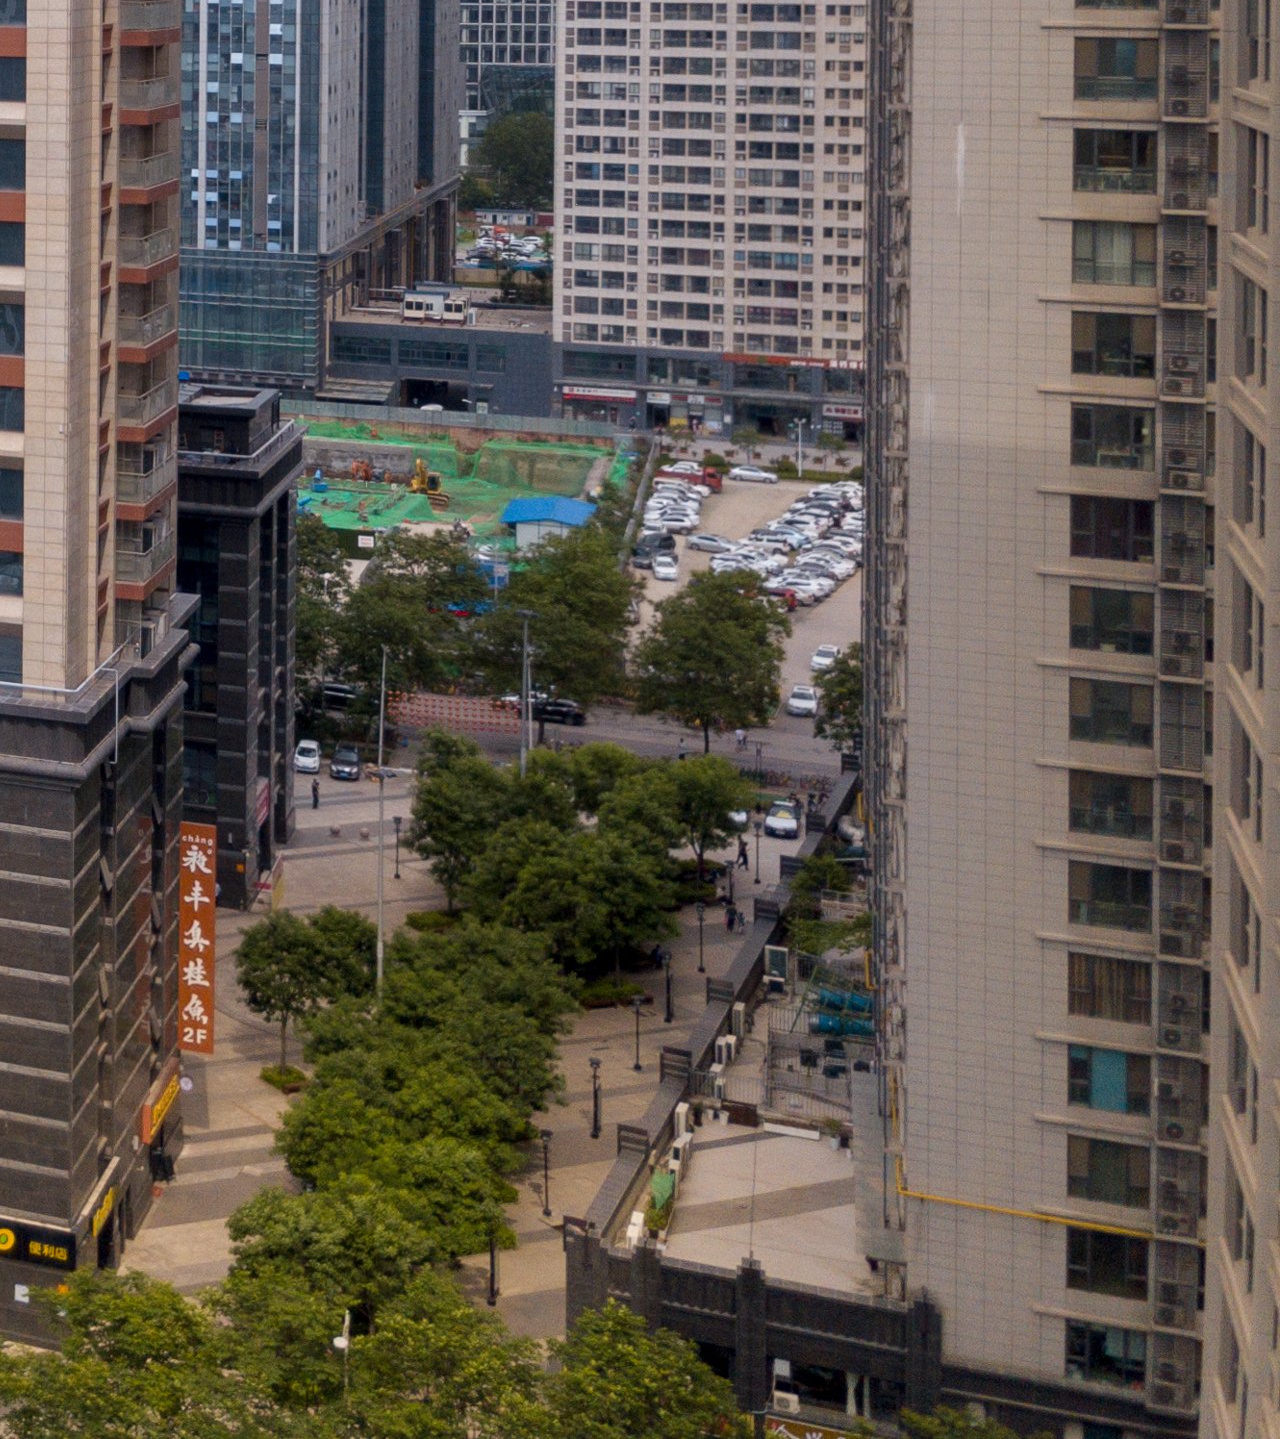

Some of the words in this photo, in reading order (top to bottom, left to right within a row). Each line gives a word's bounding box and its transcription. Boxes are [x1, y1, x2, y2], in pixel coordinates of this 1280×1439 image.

[183, 1027, 208, 1044] 2F
[29, 1241, 68, 1260] 便利店
